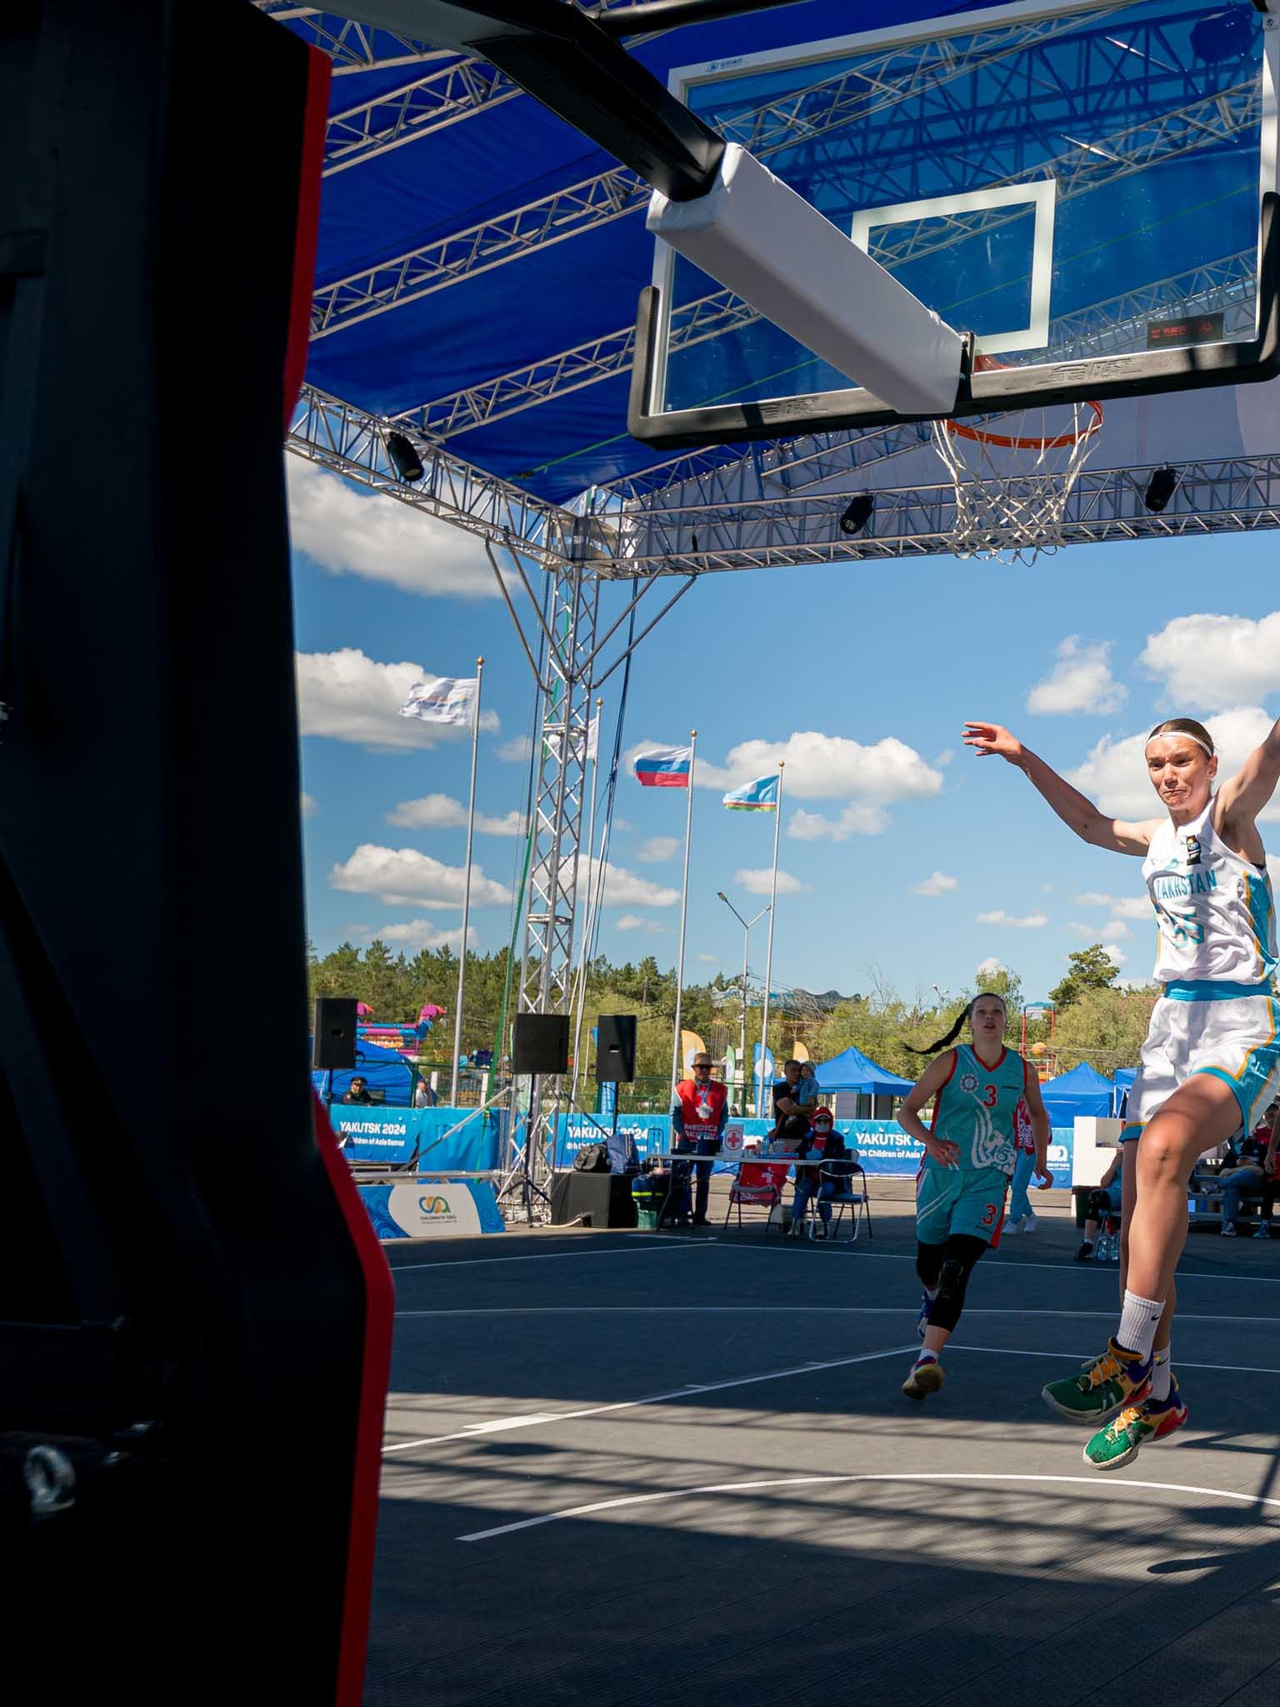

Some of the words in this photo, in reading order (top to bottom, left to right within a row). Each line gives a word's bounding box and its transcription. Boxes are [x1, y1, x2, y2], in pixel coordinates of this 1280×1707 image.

[983, 1085, 998, 1108] 3
[340, 1121, 381, 1134] YAKUTSK
[382, 1123, 406, 1135] 2024
[567, 1126, 617, 1139] YAKUTS
[856, 1132, 911, 1146] YAKUTSK
[868, 1149, 896, 1158] Children
[897, 1150, 904, 1158] of
[982, 1204, 997, 1225] 3
